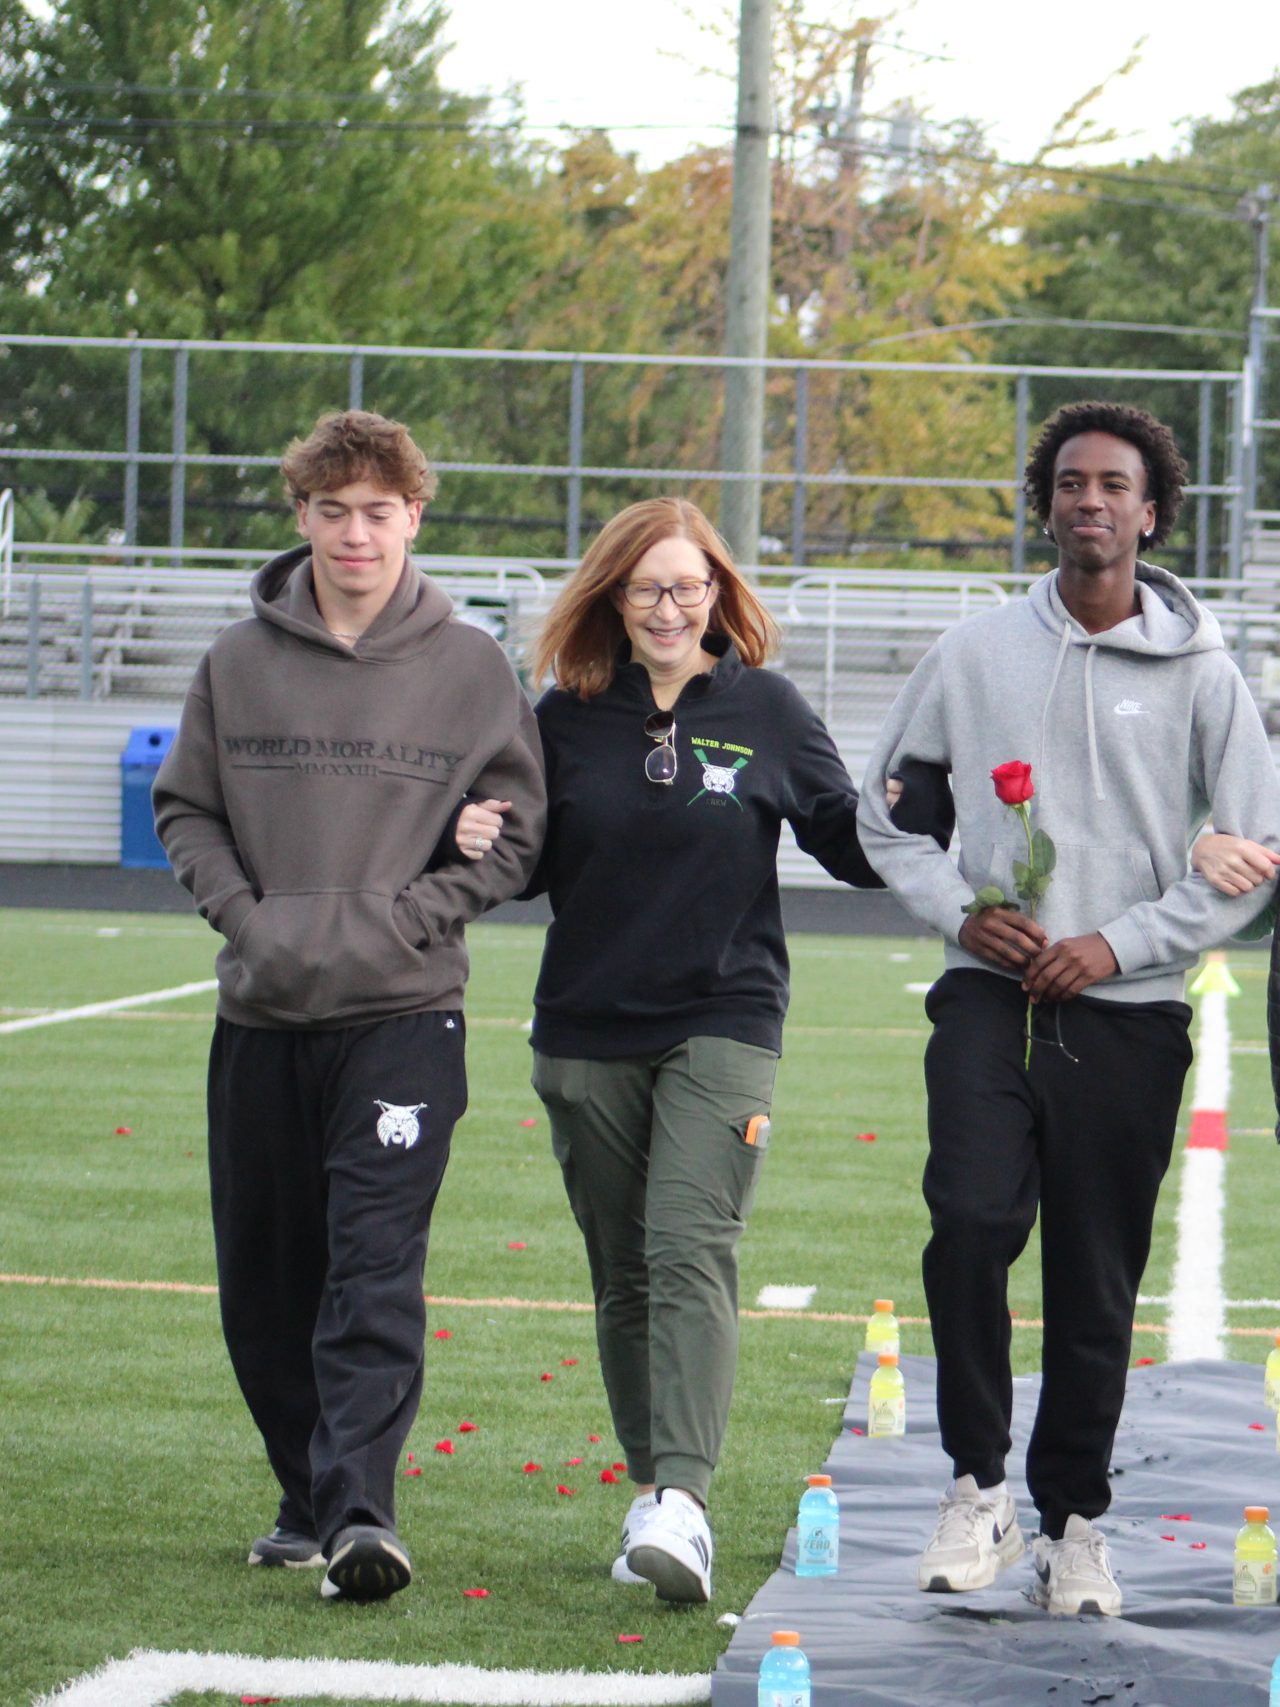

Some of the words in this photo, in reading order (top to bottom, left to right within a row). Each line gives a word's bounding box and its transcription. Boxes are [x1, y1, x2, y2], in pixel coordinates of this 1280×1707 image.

[1119, 698, 1143, 711] NIKE
[223, 736, 311, 757] WORLD
[316, 738, 464, 772] MORALITY
[690, 736, 720, 749] WALTER
[721, 742, 754, 757] JOHNSON
[294, 761, 379, 777] MMXXIII
[803, 1538, 831, 1550] ZERO
